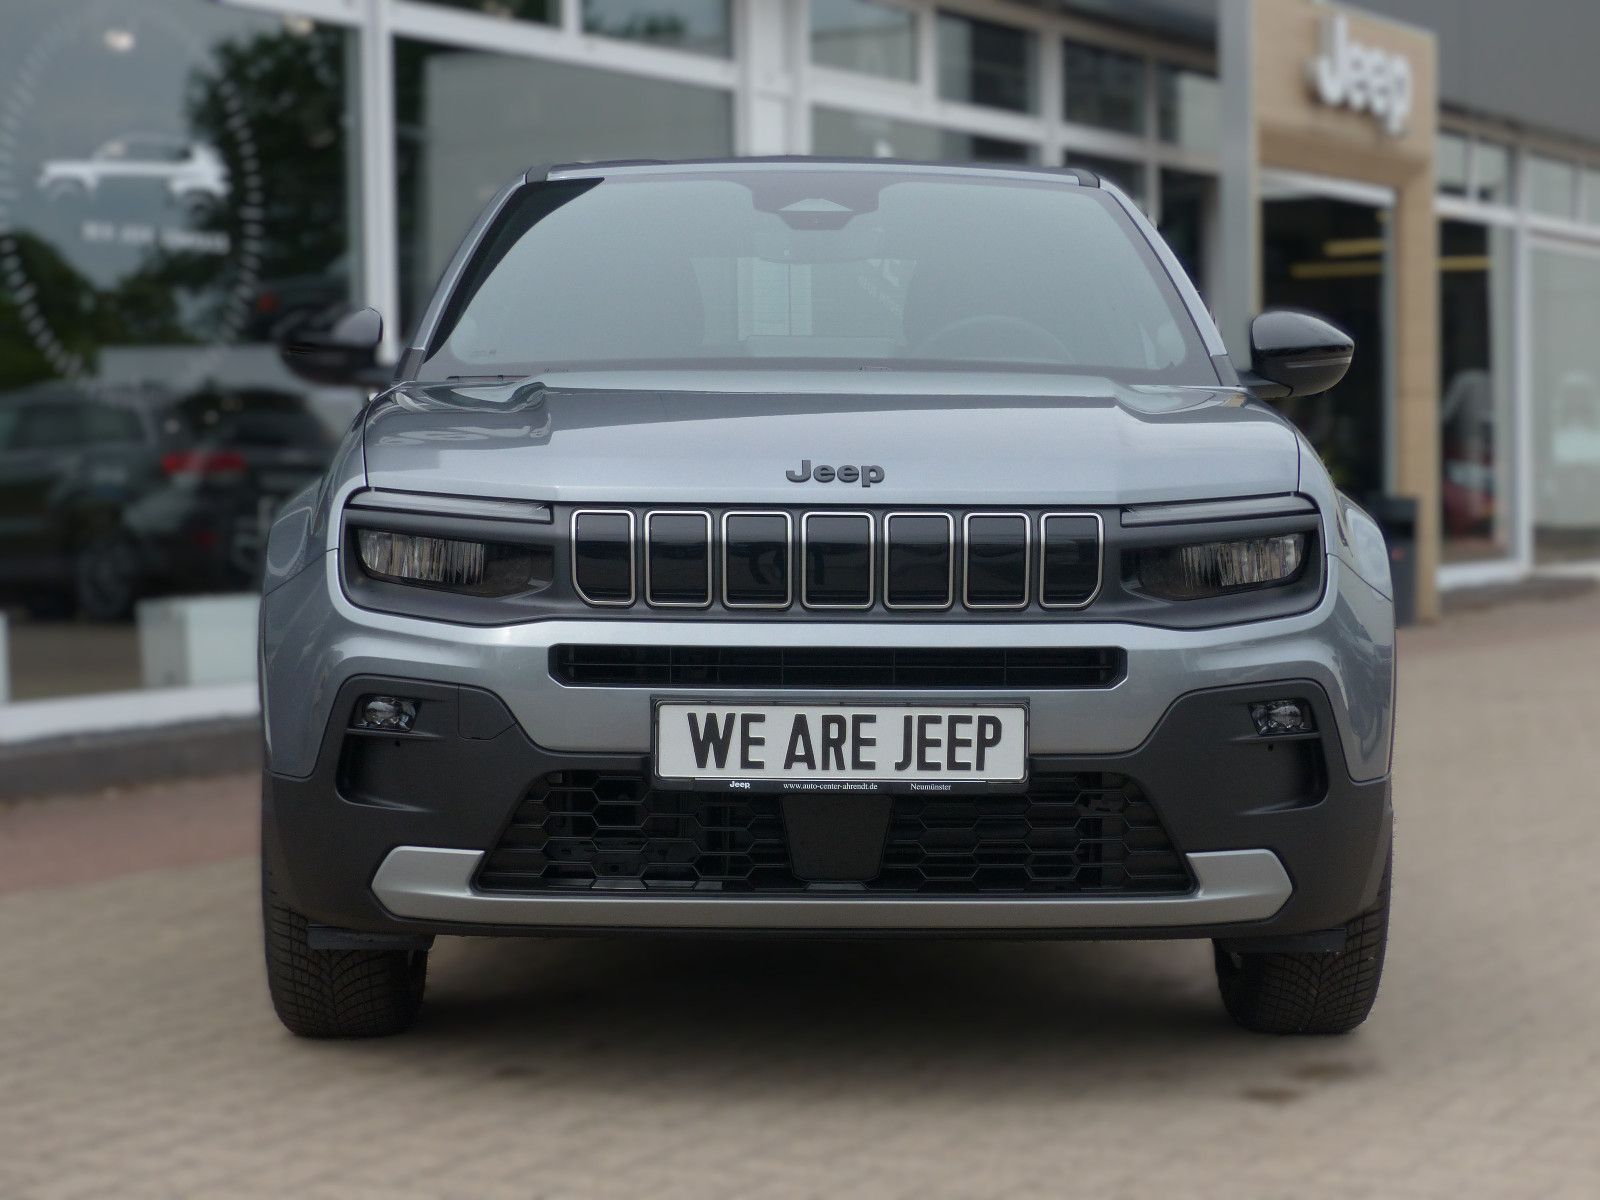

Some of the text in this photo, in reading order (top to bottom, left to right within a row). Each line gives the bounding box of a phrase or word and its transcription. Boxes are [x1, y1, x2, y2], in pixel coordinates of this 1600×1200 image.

[1307, 14, 1412, 135] Jeep
[785, 459, 885, 488] Jeep
[687, 712, 1002, 771] WE ARE JEEP
[729, 780, 751, 790] Jeep
[783, 781, 878, 791] www.auto-center-ahrendt.de
[910, 782, 952, 791] Neumünster
